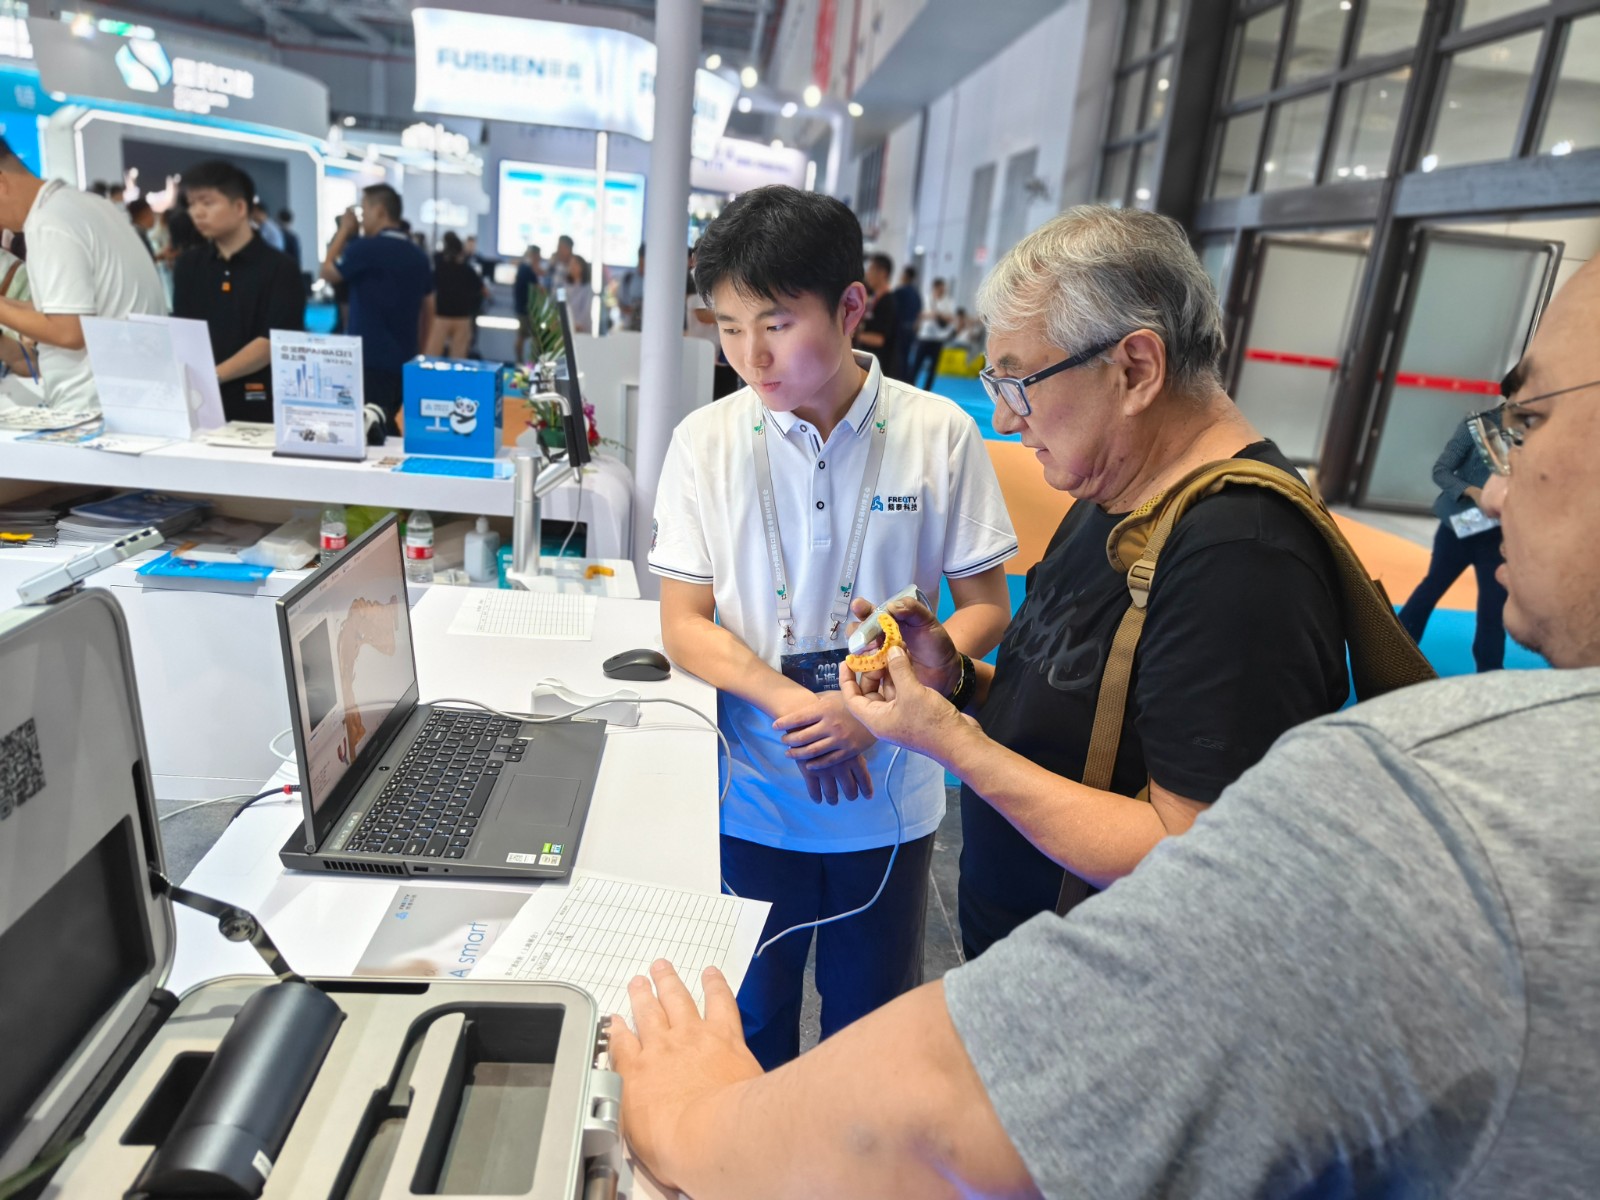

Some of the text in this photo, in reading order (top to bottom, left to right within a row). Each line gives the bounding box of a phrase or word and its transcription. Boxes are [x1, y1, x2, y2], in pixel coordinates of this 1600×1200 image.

[437, 47, 545, 78] FUSSEN
[888, 496, 918, 504] FREQTY
[817, 662, 838, 676] 202
[458, 921, 489, 965] smart
